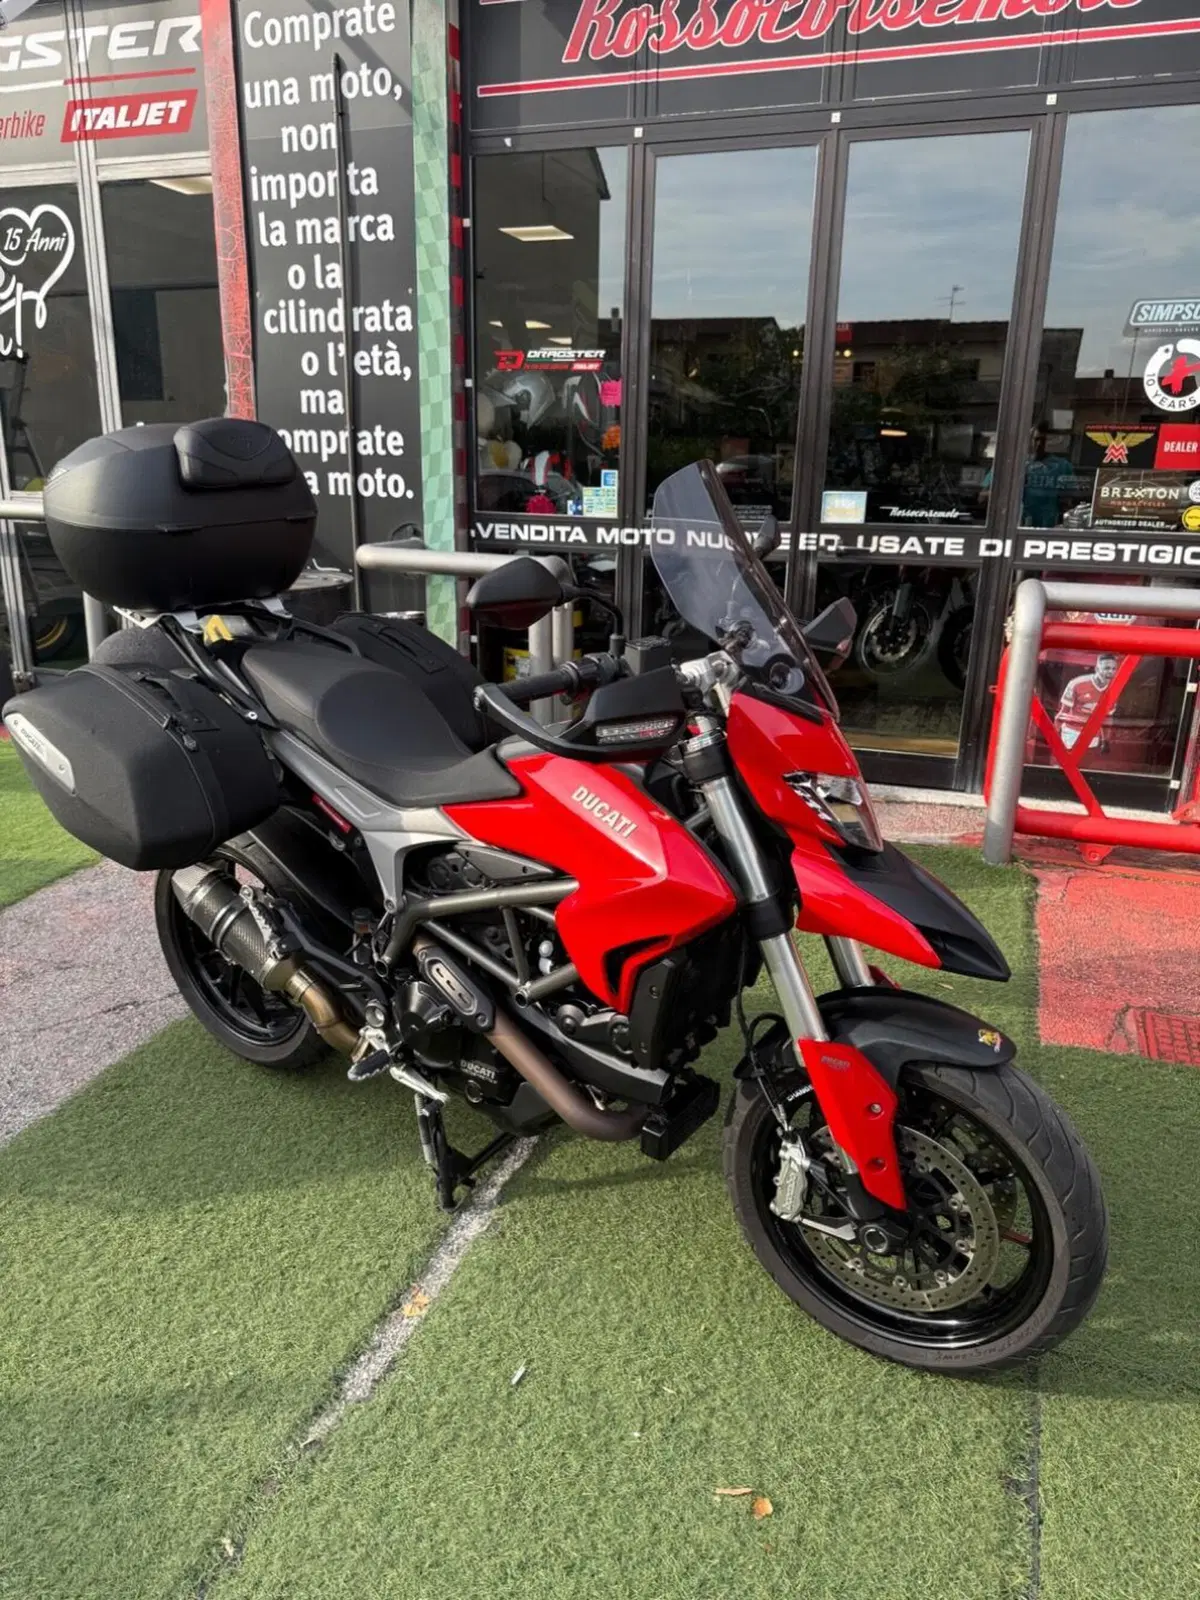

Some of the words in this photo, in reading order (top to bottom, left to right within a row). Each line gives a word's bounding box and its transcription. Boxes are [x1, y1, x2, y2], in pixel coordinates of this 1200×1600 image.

[244, 0, 396, 51] Comprate
[562, 0, 1143, 63] Rossocorse
[244, 76, 301, 109] una
[309, 62, 403, 102] moto,
[70, 100, 188, 132] ITALJET
[281, 122, 338, 153] non
[250, 161, 379, 209] importa
[4, 227, 24, 251] 15
[25, 227, 67, 252] Anni
[258, 211, 287, 247] la
[295, 213, 395, 245] marca
[287, 264, 306, 290] o
[313, 253, 342, 289] la
[264, 297, 413, 334] cilindrata
[301, 351, 319, 376] o
[527, 349, 606, 359] DRAGSTER
[300, 388, 344, 414] ma
[1146, 373, 1156, 387] 10
[1152, 390, 1197, 409] YEARS
[1163, 441, 1198, 453] DEALER
[328, 467, 414, 499] moto.
[1100, 487, 1180, 499] BRIXTON
[1138, 521, 1165, 529] DEALER
[476, 522, 588, 544] VENDITA
[596, 526, 676, 545] MOTO
[857, 535, 965, 556] USATE
[979, 538, 1012, 557] DI
[1024, 540, 1200, 566] PRESTIGIO
[571, 785, 637, 838] DUCATI
[460, 1060, 496, 1079] DUCATI
